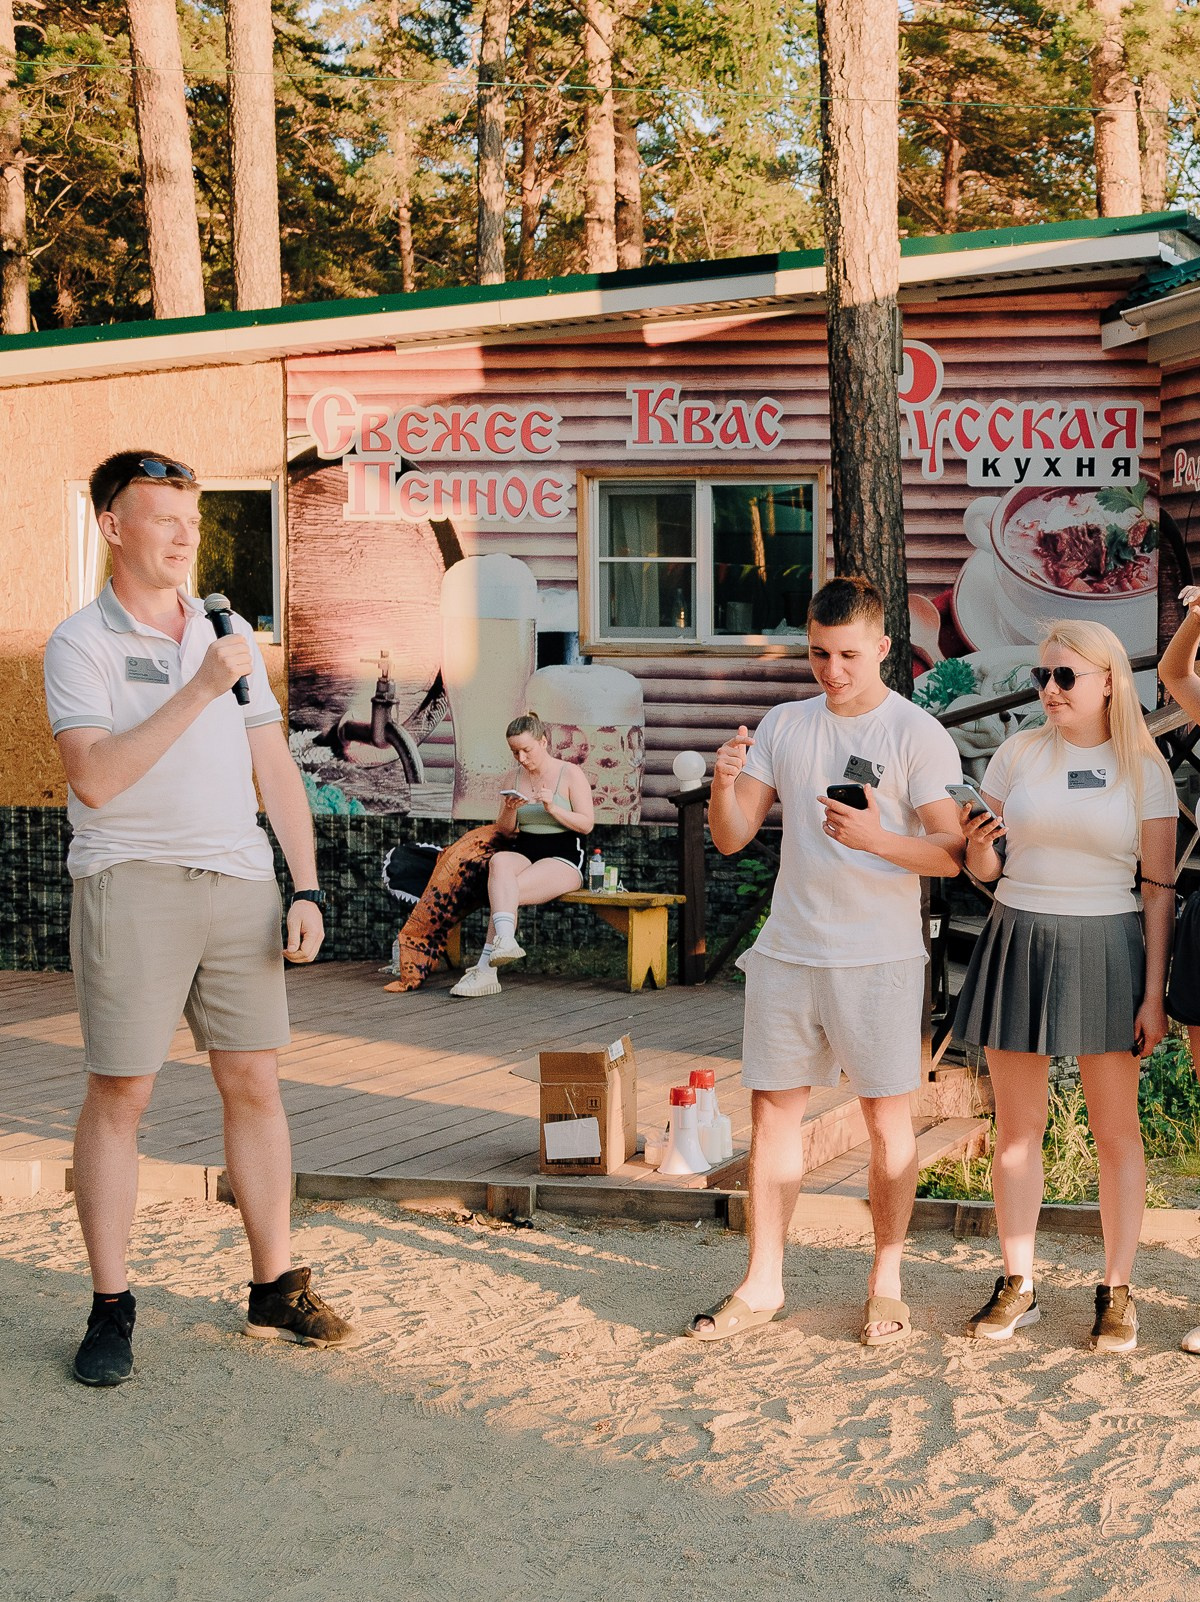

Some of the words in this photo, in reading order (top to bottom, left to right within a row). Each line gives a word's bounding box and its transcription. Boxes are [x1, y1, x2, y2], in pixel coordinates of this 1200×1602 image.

[311, 393, 554, 454] Свежее
[632, 387, 779, 446] Квас
[350, 461, 563, 518] Пенное
[982, 456, 1131, 484] кухня
